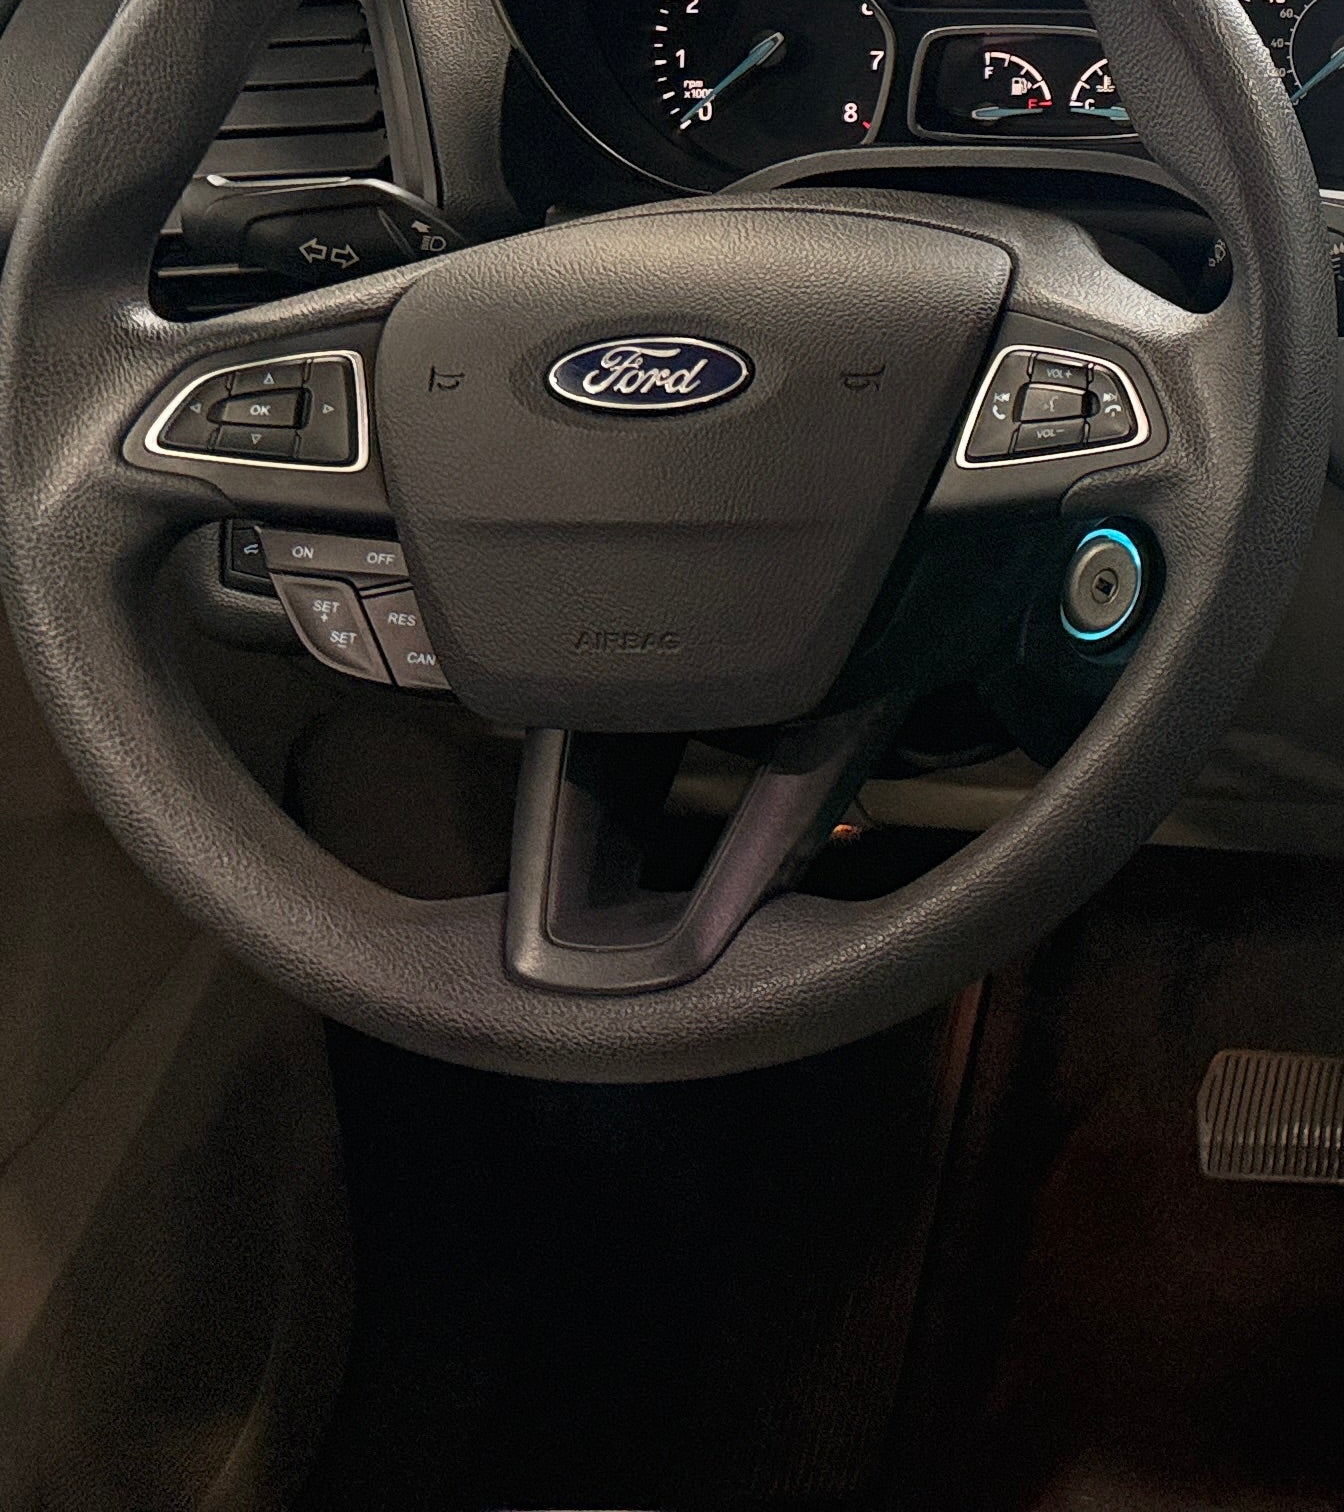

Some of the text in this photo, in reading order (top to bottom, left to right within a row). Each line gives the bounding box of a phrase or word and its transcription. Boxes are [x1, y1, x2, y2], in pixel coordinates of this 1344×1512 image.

[1280, 8, 1294, 19] 60
[1271, 38, 1284, 49] 40
[675, 49, 685, 69] 1
[870, 51, 884, 71] 7
[984, 66, 993, 79] F
[683, 80, 703, 90] rpm
[698, 100, 713, 121] 0
[1028, 99, 1038, 109] E
[1085, 99, 1095, 111] C
[844, 103, 858, 123] 8
[583, 346, 709, 395] Ford
[250, 405, 270, 416] OK
[292, 546, 314, 559] ON
[367, 552, 395, 566] OFF
[313, 600, 340, 612] SET
[388, 613, 416, 627] RES
[330, 632, 357, 645] SET
[574, 631, 682, 654] AIRBAG
[407, 651, 436, 666] CAN
